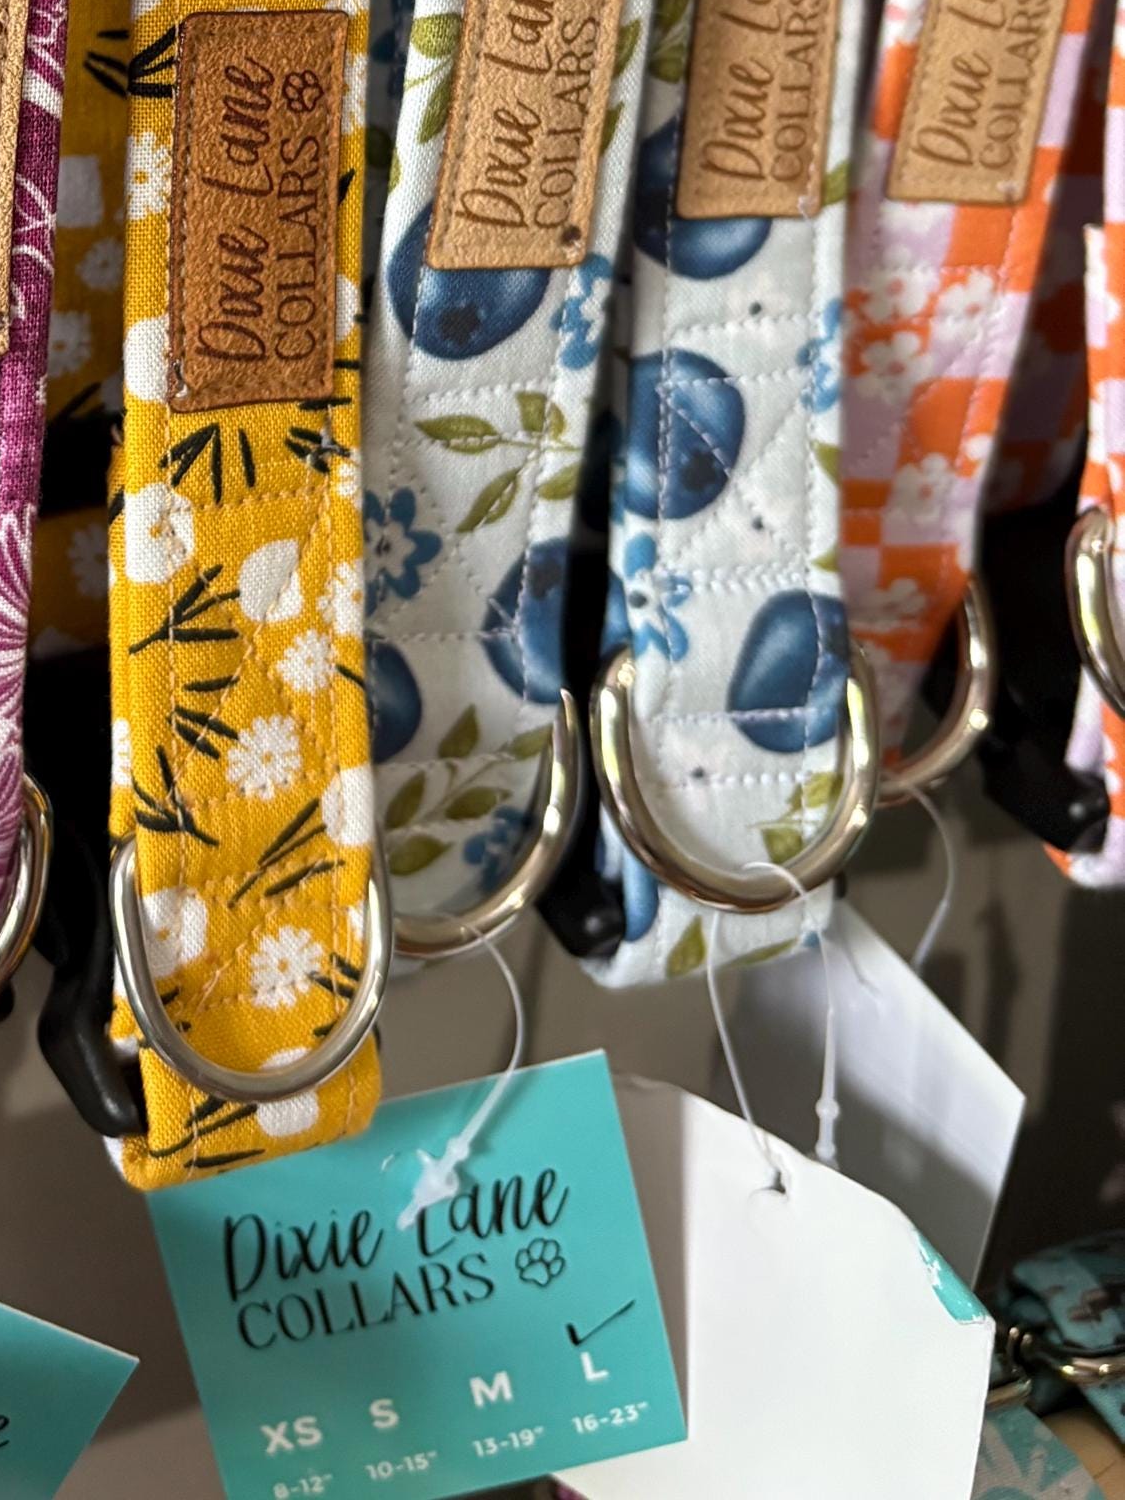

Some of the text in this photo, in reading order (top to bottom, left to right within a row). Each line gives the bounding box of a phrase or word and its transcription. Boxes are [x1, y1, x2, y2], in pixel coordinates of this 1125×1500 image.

[455, 99, 542, 229] Dixie
[533, 16, 600, 230] COLLARS
[698, 58, 774, 181] Dixie
[911, 51, 992, 167] Dixie
[195, 56, 275, 363] Dixie Lane
[275, 135, 321, 361] COLLARS
[223, 1167, 569, 1301] Dixie Lane
[237, 1252, 495, 1350] COLLARS
[261, 1351, 609, 1455] XS S M L
[365, 1450, 438, 1481] 10-15"
[472, 1426, 545, 1458] 13-19"
[572, 1401, 648, 1434] 16-23"
